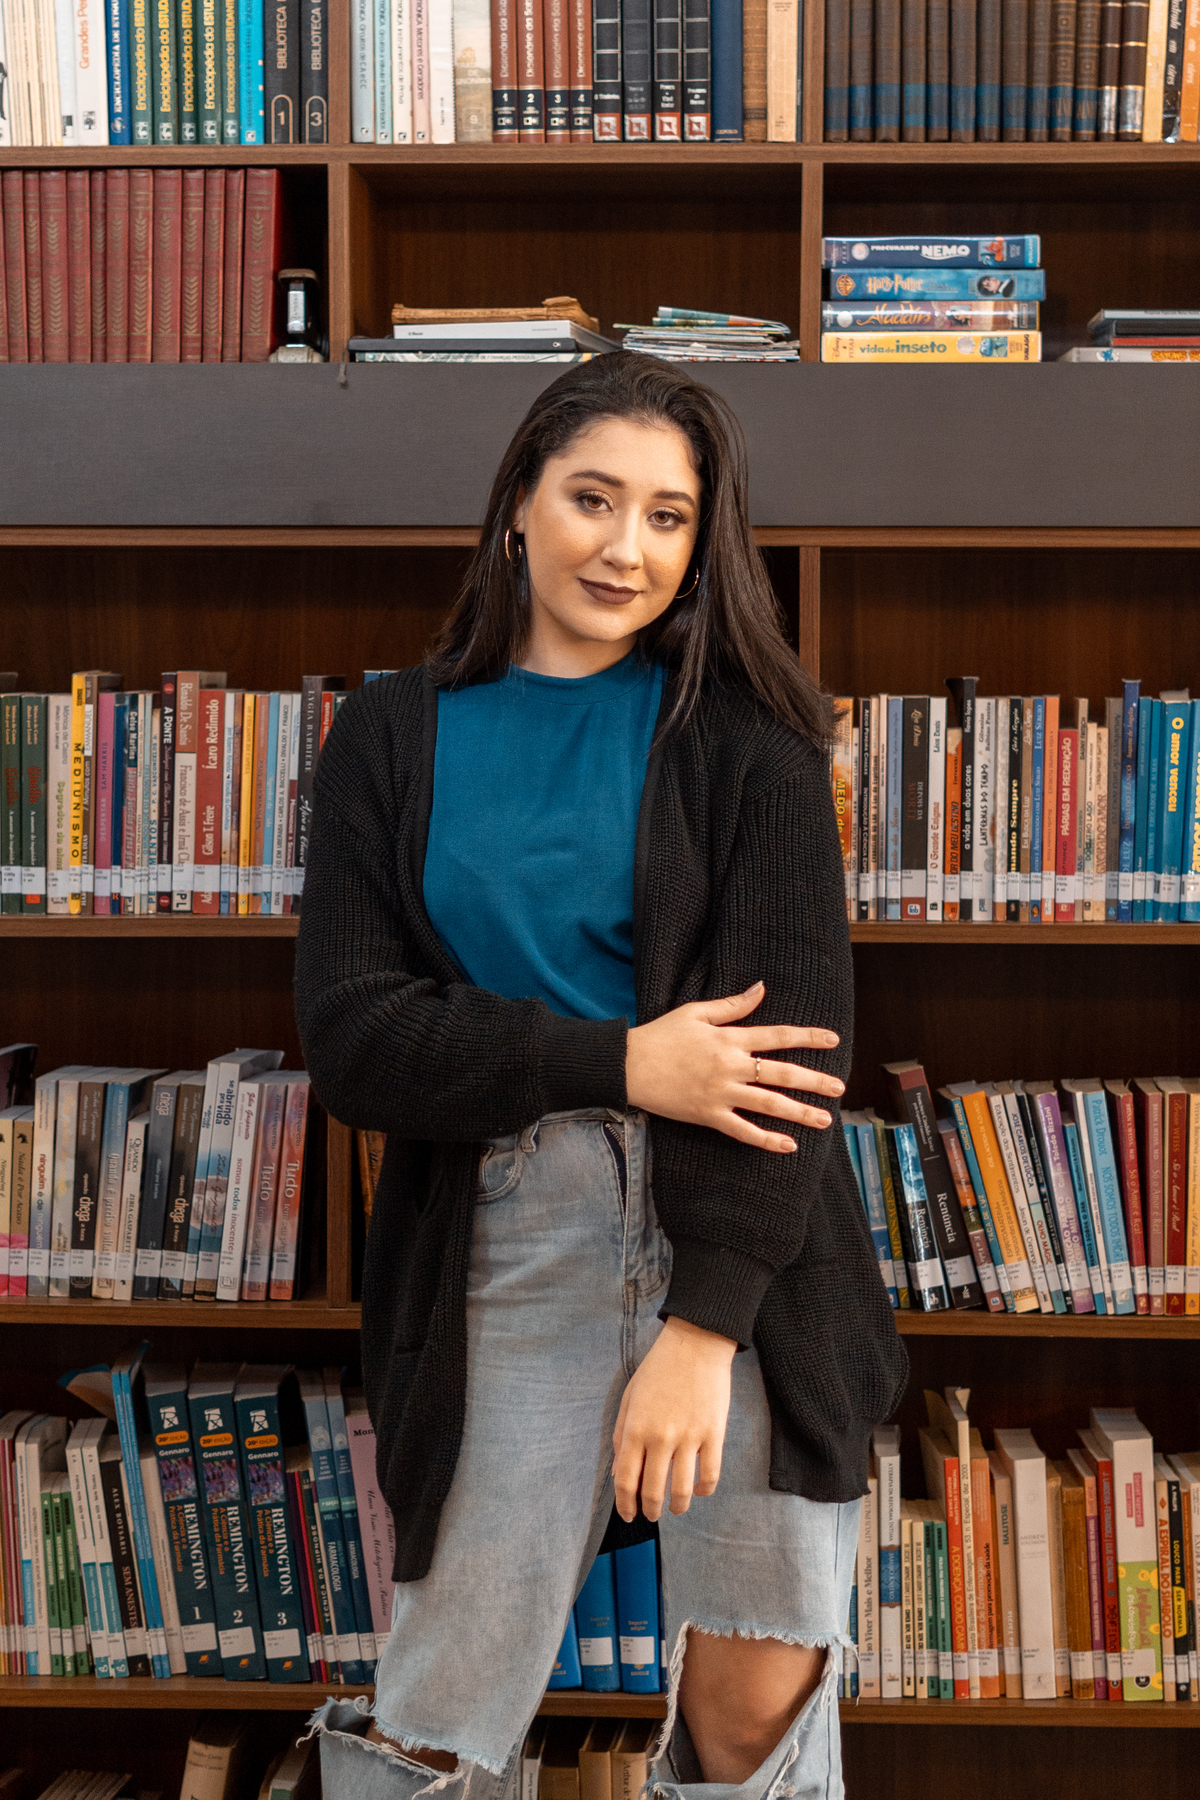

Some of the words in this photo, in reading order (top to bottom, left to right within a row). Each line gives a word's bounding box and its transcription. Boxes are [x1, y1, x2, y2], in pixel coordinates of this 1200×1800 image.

[135, 28, 145, 43] do
[159, 29, 169, 44] do
[182, 29, 192, 44] do
[204, 27, 214, 42] do
[277, 6, 287, 69] BIBLIOTECA
[311, 7, 321, 70] BIBLIOTECA
[527, 93, 535, 103] 2
[555, 94, 561, 104] 3
[578, 93, 585, 103] 4
[311, 112, 322, 126] 3
[921, 244, 971, 259] NEMO
[856, 303, 933, 326] Aladdin
[860, 342, 885, 354] vida
[896, 340, 947, 353] inseto
[165, 707, 174, 715] A
[307, 690, 315, 720] LYGIA
[130, 711, 138, 731] Celso
[164, 716, 174, 745] PONTE
[206, 698, 219, 744] Redimido
[1172, 717, 1184, 730] O
[130, 733, 138, 760] Martins
[201, 745, 218, 770] Ícaro
[1170, 732, 1181, 765] amor
[1060, 737, 1071, 787] REDENÇÃO
[179, 765, 191, 795] Francisco
[964, 765, 973, 787] cores
[979, 763, 988, 789] TEMPO
[72, 743, 83, 859] MEDIUNISMO
[179, 796, 190, 807] de
[837, 778, 847, 815] MEDO
[963, 788, 972, 808] duas
[1061, 788, 1070, 802] EM
[1167, 767, 1179, 812] venceu
[202, 804, 214, 826] Freire
[964, 810, 971, 821] em
[1010, 779, 1019, 828] Sempre
[1085, 801, 1093, 822] LADO
[178, 808, 190, 827] Assis
[950, 801, 959, 833] DESTINO
[978, 804, 988, 846] LANTERNAS
[1061, 802, 1071, 836] PÁRIAS
[202, 833, 214, 856] Gilson
[276, 823, 284, 847] UBERABA
[951, 833, 960, 850] MEU
[964, 822, 972, 843] vida
[1121, 841, 1130, 859] LUZ
[156, 1091, 173, 1115] chega
[218, 1093, 226, 1104] pra
[222, 1088, 235, 1126] abrindo
[215, 1105, 226, 1125] vida
[954, 1103, 964, 1126] XAVIER
[994, 1104, 1008, 1137] Educação
[1012, 1112, 1022, 1128] JOSÉ
[1045, 1107, 1056, 1134] Rizzini
[1092, 1098, 1104, 1126] Patrick
[295, 1110, 305, 1147] Gasparetto
[961, 1130, 971, 1151] CHICO
[1003, 1138, 1011, 1150] dos
[1016, 1128, 1026, 1155] CARLOS
[1051, 1135, 1060, 1161] Toledo
[1096, 1126, 1107, 1156] Drouot
[132, 1137, 142, 1172] QUANDO
[1021, 1155, 1028, 1165] DE
[37, 1153, 47, 1190] ninguém
[235, 1158, 243, 1185] somos
[260, 1162, 275, 1201] Tudo
[284, 1159, 300, 1198] Tudo
[1006, 1151, 1021, 1193] Sentimentos
[1023, 1165, 1034, 1188] LUCCA
[37, 1199, 45, 1211] de
[75, 1196, 94, 1222] chega
[128, 1193, 136, 1212] ZIBIA
[232, 1187, 241, 1211] todos
[978, 1194, 988, 1210] LUZ
[1104, 1184, 1116, 1210] SOMOS
[1131, 1188, 1140, 1210] Amor
[1153, 1188, 1162, 1210] Amor
[170, 1197, 189, 1223] chega
[937, 1192, 957, 1243] Renúncia
[982, 1210, 989, 1221] DE
[1018, 1205, 1028, 1225] Jason
[35, 1211, 45, 1249] ninguém
[917, 1208, 931, 1249] Renúncia
[1022, 1226, 1029, 1235] de
[1036, 1219, 1046, 1240] OLHO
[1108, 1211, 1120, 1237] TODOS
[1133, 1218, 1142, 1235] Real
[1153, 1218, 1162, 1235] Real
[159, 1446, 189, 1458] Gennaro
[203, 1448, 233, 1459] Gennaro
[248, 1450, 278, 1461] Gennaro
[111, 1488, 120, 1509] ALEX
[169, 1505, 178, 1530] Prática
[178, 1511, 186, 1537] Ciência
[211, 1507, 221, 1532] Prática
[221, 1514, 229, 1540] Ciência
[256, 1509, 265, 1534] Prática
[265, 1516, 274, 1542] Ciência
[1000, 1504, 1009, 1545] HALITOSE
[1159, 1518, 1168, 1528] A
[172, 1530, 179, 1540] da
[183, 1503, 208, 1591] REMINGTON
[214, 1532, 222, 1543] da
[258, 1534, 266, 1544] da
[311, 1525, 324, 1564] HIPNOSE
[173, 1540, 183, 1572] Farmácia
[216, 1543, 225, 1575] Farmácia
[227, 1505, 249, 1593] REMINGTON
[260, 1545, 269, 1577] Farmácia
[272, 1507, 294, 1595] REMINGTON
[983, 1543, 991, 1561] saúde
[1159, 1529, 1170, 1572] ESPIRAL
[122, 1566, 133, 1586] SEM
[327, 1541, 342, 1592] FARMACOLOGIA
[865, 1556, 873, 1588] Melhor
[952, 1554, 963, 1593] DOENÇA
[985, 1561, 992, 1570] da
[976, 1556, 986, 1610] Enfermagem
[985, 1571, 994, 1602] promoção
[1161, 1574, 1170, 1589] DO
[865, 1596, 873, 1618] Mais
[953, 1594, 963, 1625] COMO
[966, 1593, 974, 1602] de
[233, 1609, 243, 1623] 2
[277, 1611, 288, 1625] 3
[966, 1603, 975, 1631] Brasileira
[986, 1604, 994, 1616] para
[1176, 1604, 1184, 1634] NORMAL
[865, 1620, 873, 1642] Viver
